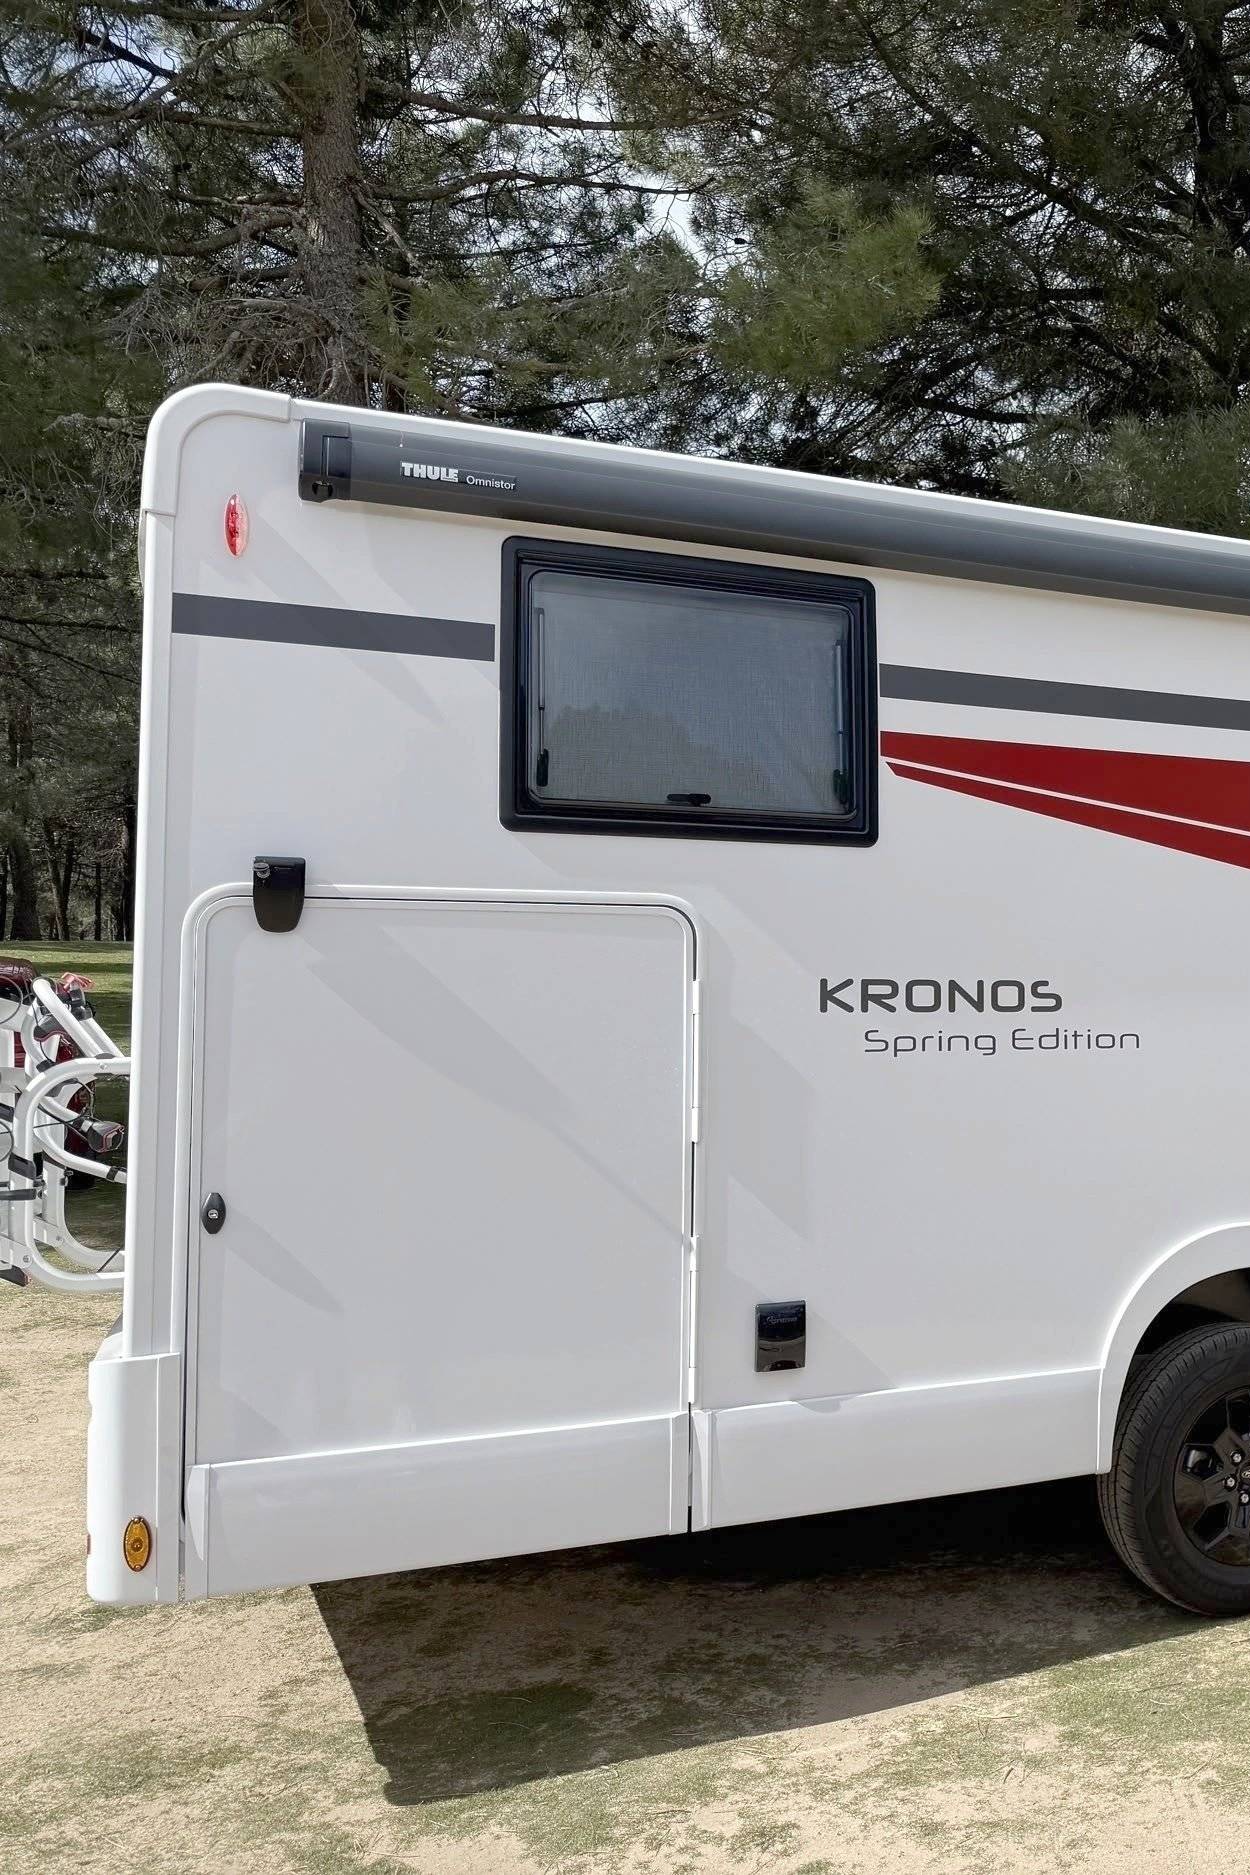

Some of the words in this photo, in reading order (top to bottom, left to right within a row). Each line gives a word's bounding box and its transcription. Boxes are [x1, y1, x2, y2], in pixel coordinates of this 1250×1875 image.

[401, 462, 459, 483] THULE
[466, 475, 516, 490] Omnistor
[819, 978, 1063, 1013] KRONOS
[864, 1029, 997, 1058] Spring
[1011, 1027, 1140, 1051] Edition
